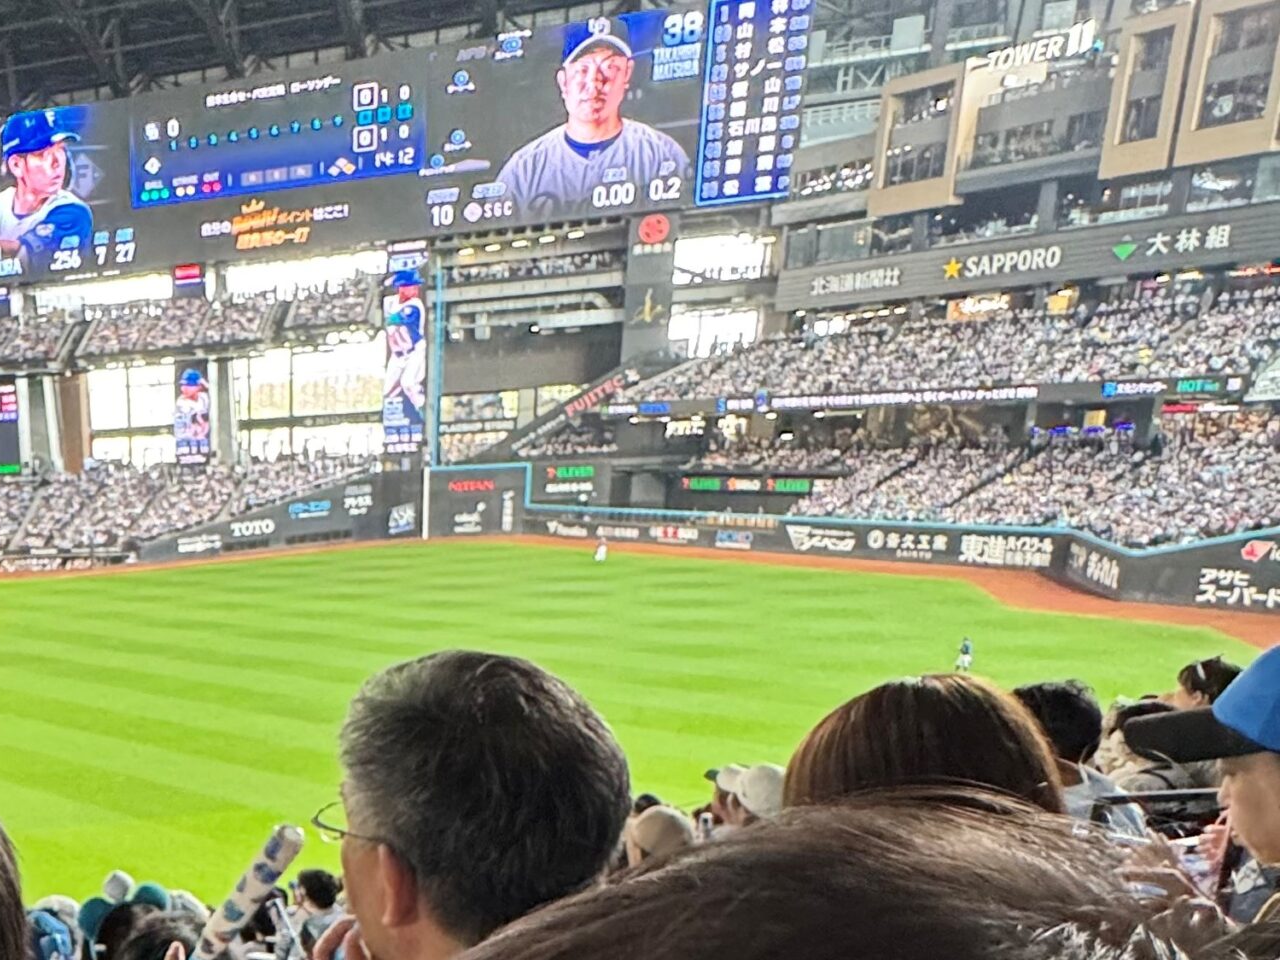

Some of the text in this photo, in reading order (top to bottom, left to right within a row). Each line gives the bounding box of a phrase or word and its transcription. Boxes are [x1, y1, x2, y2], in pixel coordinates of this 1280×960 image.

[663, 11, 704, 47] 38
[986, 36, 1065, 71] TOWER
[380, 88, 388, 103] 1
[399, 85, 410, 100] 0
[380, 127, 388, 141] 1
[398, 124, 410, 139] 0
[374, 147, 415, 168] 14:12
[592, 176, 681, 207] 0.00 0.2
[431, 204, 454, 227] 10
[1145, 224, 1231, 257] 大林組
[50, 242, 136, 270] .256 7 27
[963, 246, 1062, 278] SAPPORO
[564, 374, 624, 417] FUJITEC
[231, 518, 275, 537] TOTO
[959, 534, 1005, 564] 東進
[1006, 536, 1053, 553] ハイスクール
[1199, 568, 1250, 586] アサヒ
